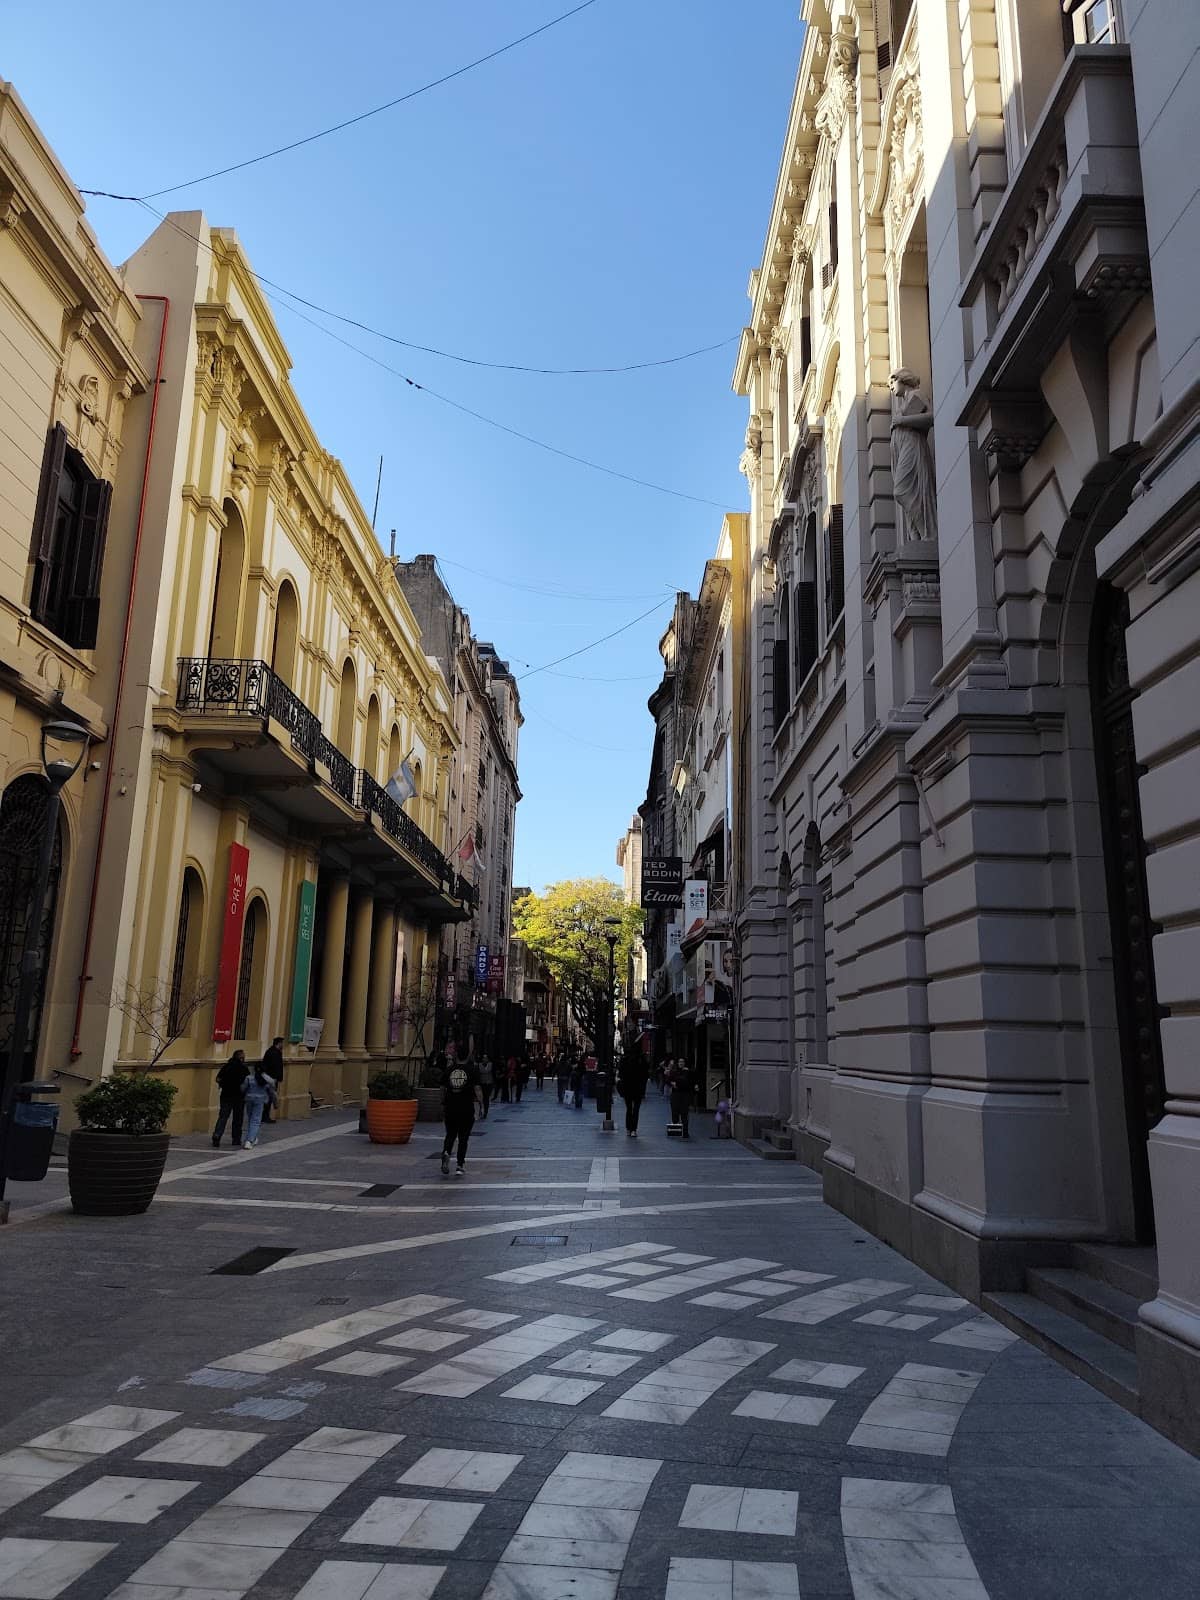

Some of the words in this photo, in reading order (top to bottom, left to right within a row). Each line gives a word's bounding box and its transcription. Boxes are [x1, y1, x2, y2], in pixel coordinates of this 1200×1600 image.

[643, 861, 666, 869] TED
[643, 869, 681, 878] BODIN
[478, 946, 487, 973] DANDY
